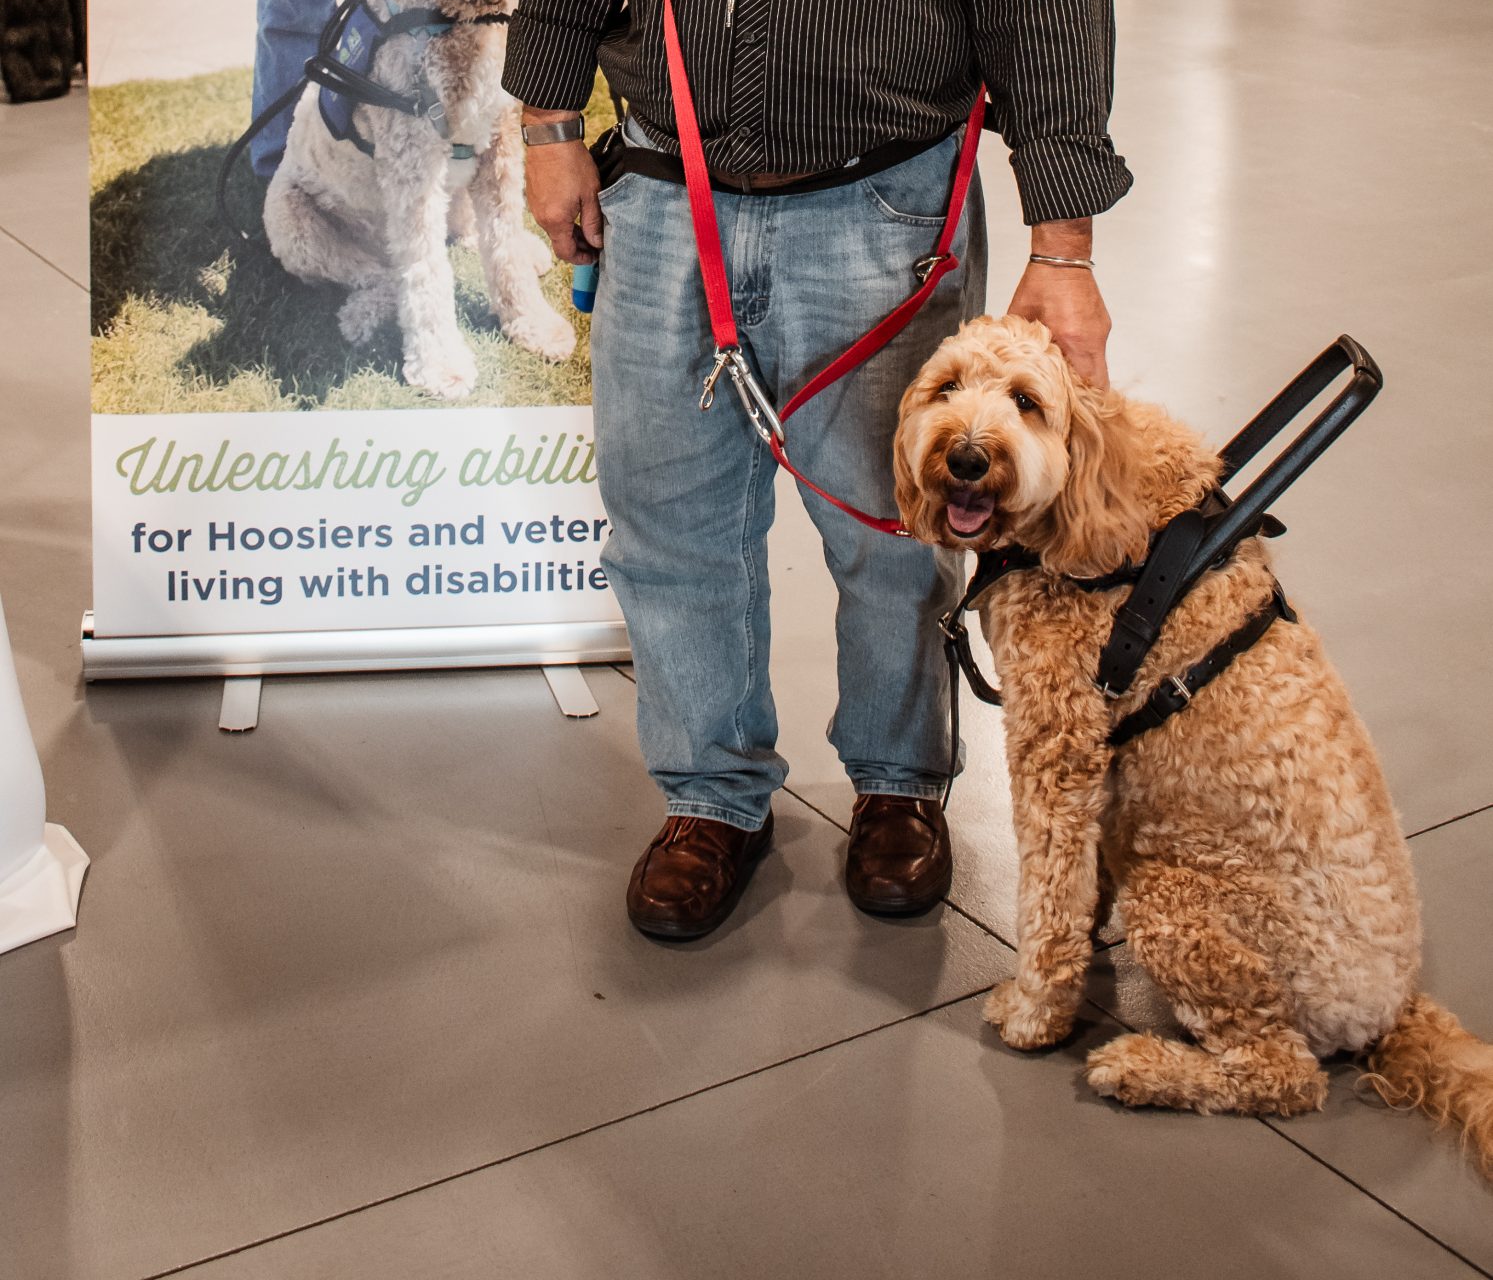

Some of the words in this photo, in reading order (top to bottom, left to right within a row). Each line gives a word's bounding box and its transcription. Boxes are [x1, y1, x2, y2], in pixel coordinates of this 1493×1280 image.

[116, 436, 447, 507] Unleashing
[130, 522, 192, 554] for
[208, 518, 393, 552] Hoosiers
[408, 515, 485, 548] and
[500, 515, 613, 545] veter
[167, 569, 283, 606] living
[299, 565, 390, 599] with
